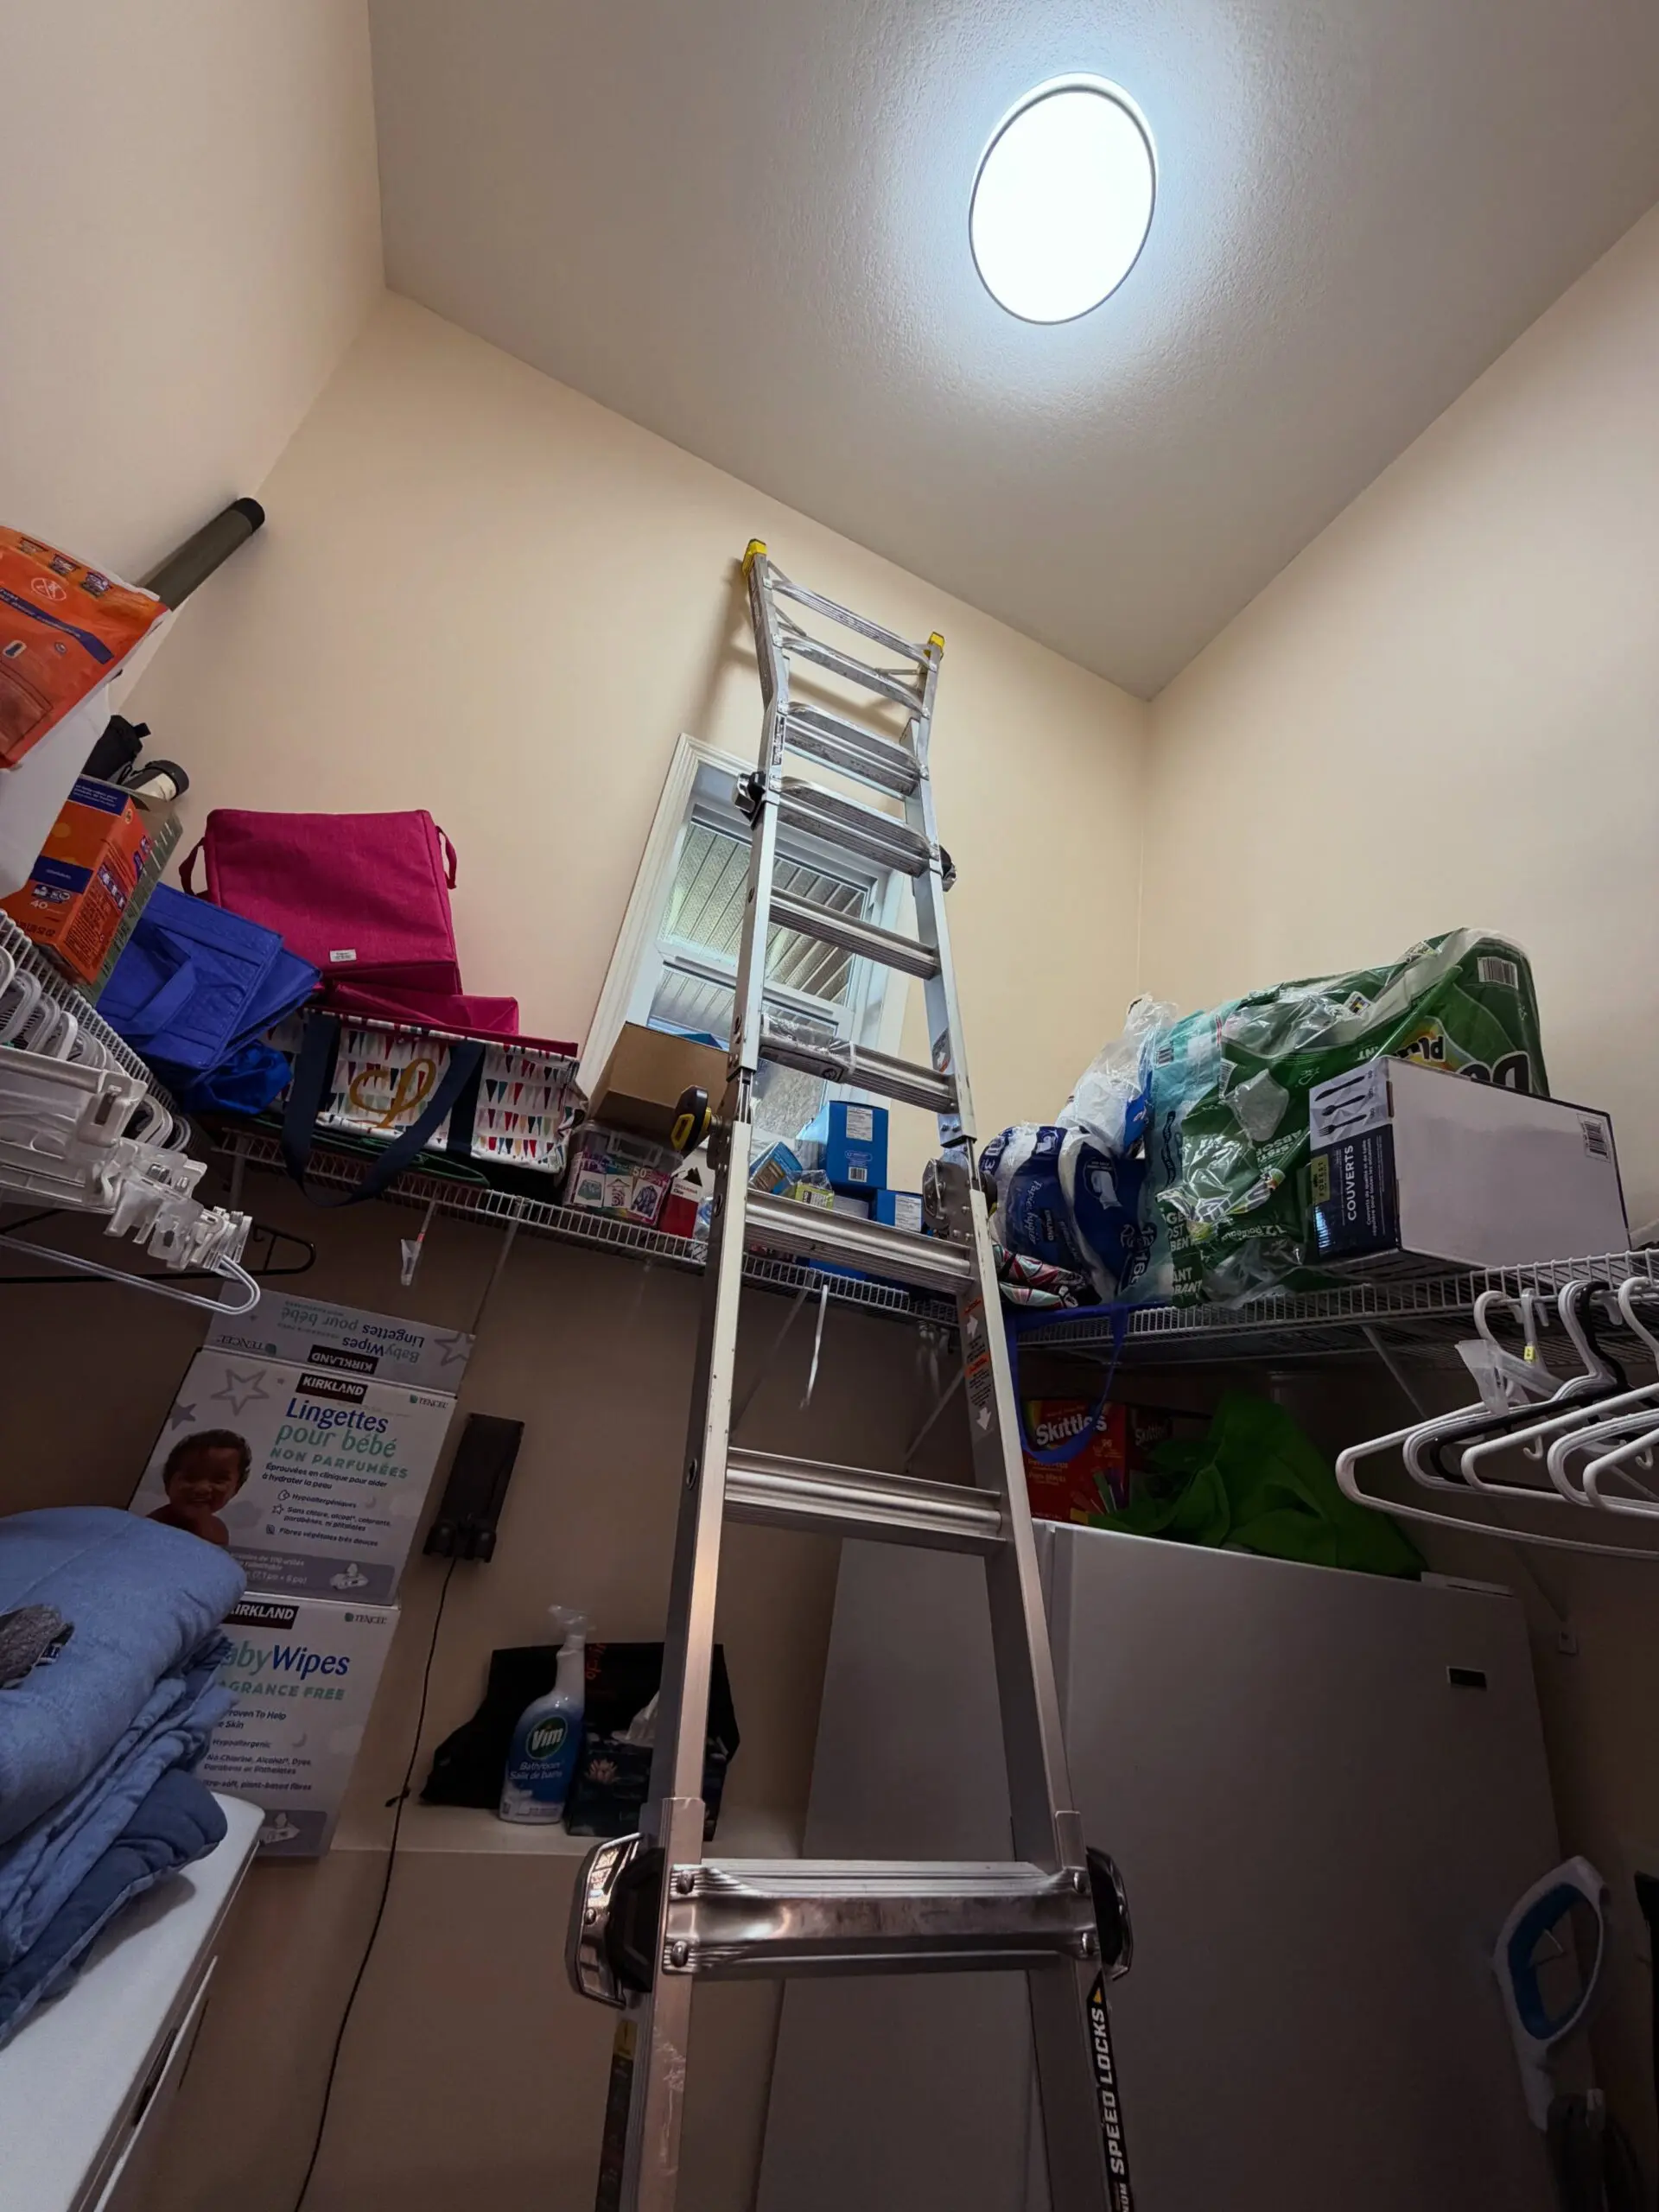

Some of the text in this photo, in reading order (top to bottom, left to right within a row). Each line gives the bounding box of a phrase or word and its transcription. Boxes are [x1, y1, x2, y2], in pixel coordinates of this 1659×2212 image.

[1344, 1144, 1357, 1221] COUVERTS
[281, 1306, 320, 1326] bébé
[323, 1313, 359, 1332] pour
[362, 1324, 424, 1347] Lingettes
[313, 1351, 374, 1372] KIRKLAND
[302, 1376, 364, 1397] KIRKLAND
[285, 1397, 389, 1433] Lingettes
[274, 1424, 397, 1459] pour bébé
[265, 1461, 308, 1478] Éprouvées
[308, 1470, 318, 1478] en
[319, 1471, 348, 1484] clinique
[348, 1476, 368, 1485] pour
[270, 1446, 410, 1479] NON PARFUMÉES
[268, 1474, 302, 1487] hydrater
[303, 1478, 311, 1487] la
[312, 1480, 333, 1491] peau
[279, 1527, 301, 1537] Fibres
[304, 1686, 345, 1700] FREE
[225, 1720, 244, 1729] Skin
[255, 1710, 266, 1719] To
[266, 1711, 287, 1720] Help
[531, 1727, 564, 1751] Vim
[1090, 2006, 1126, 2177] SPEED LOCKS
